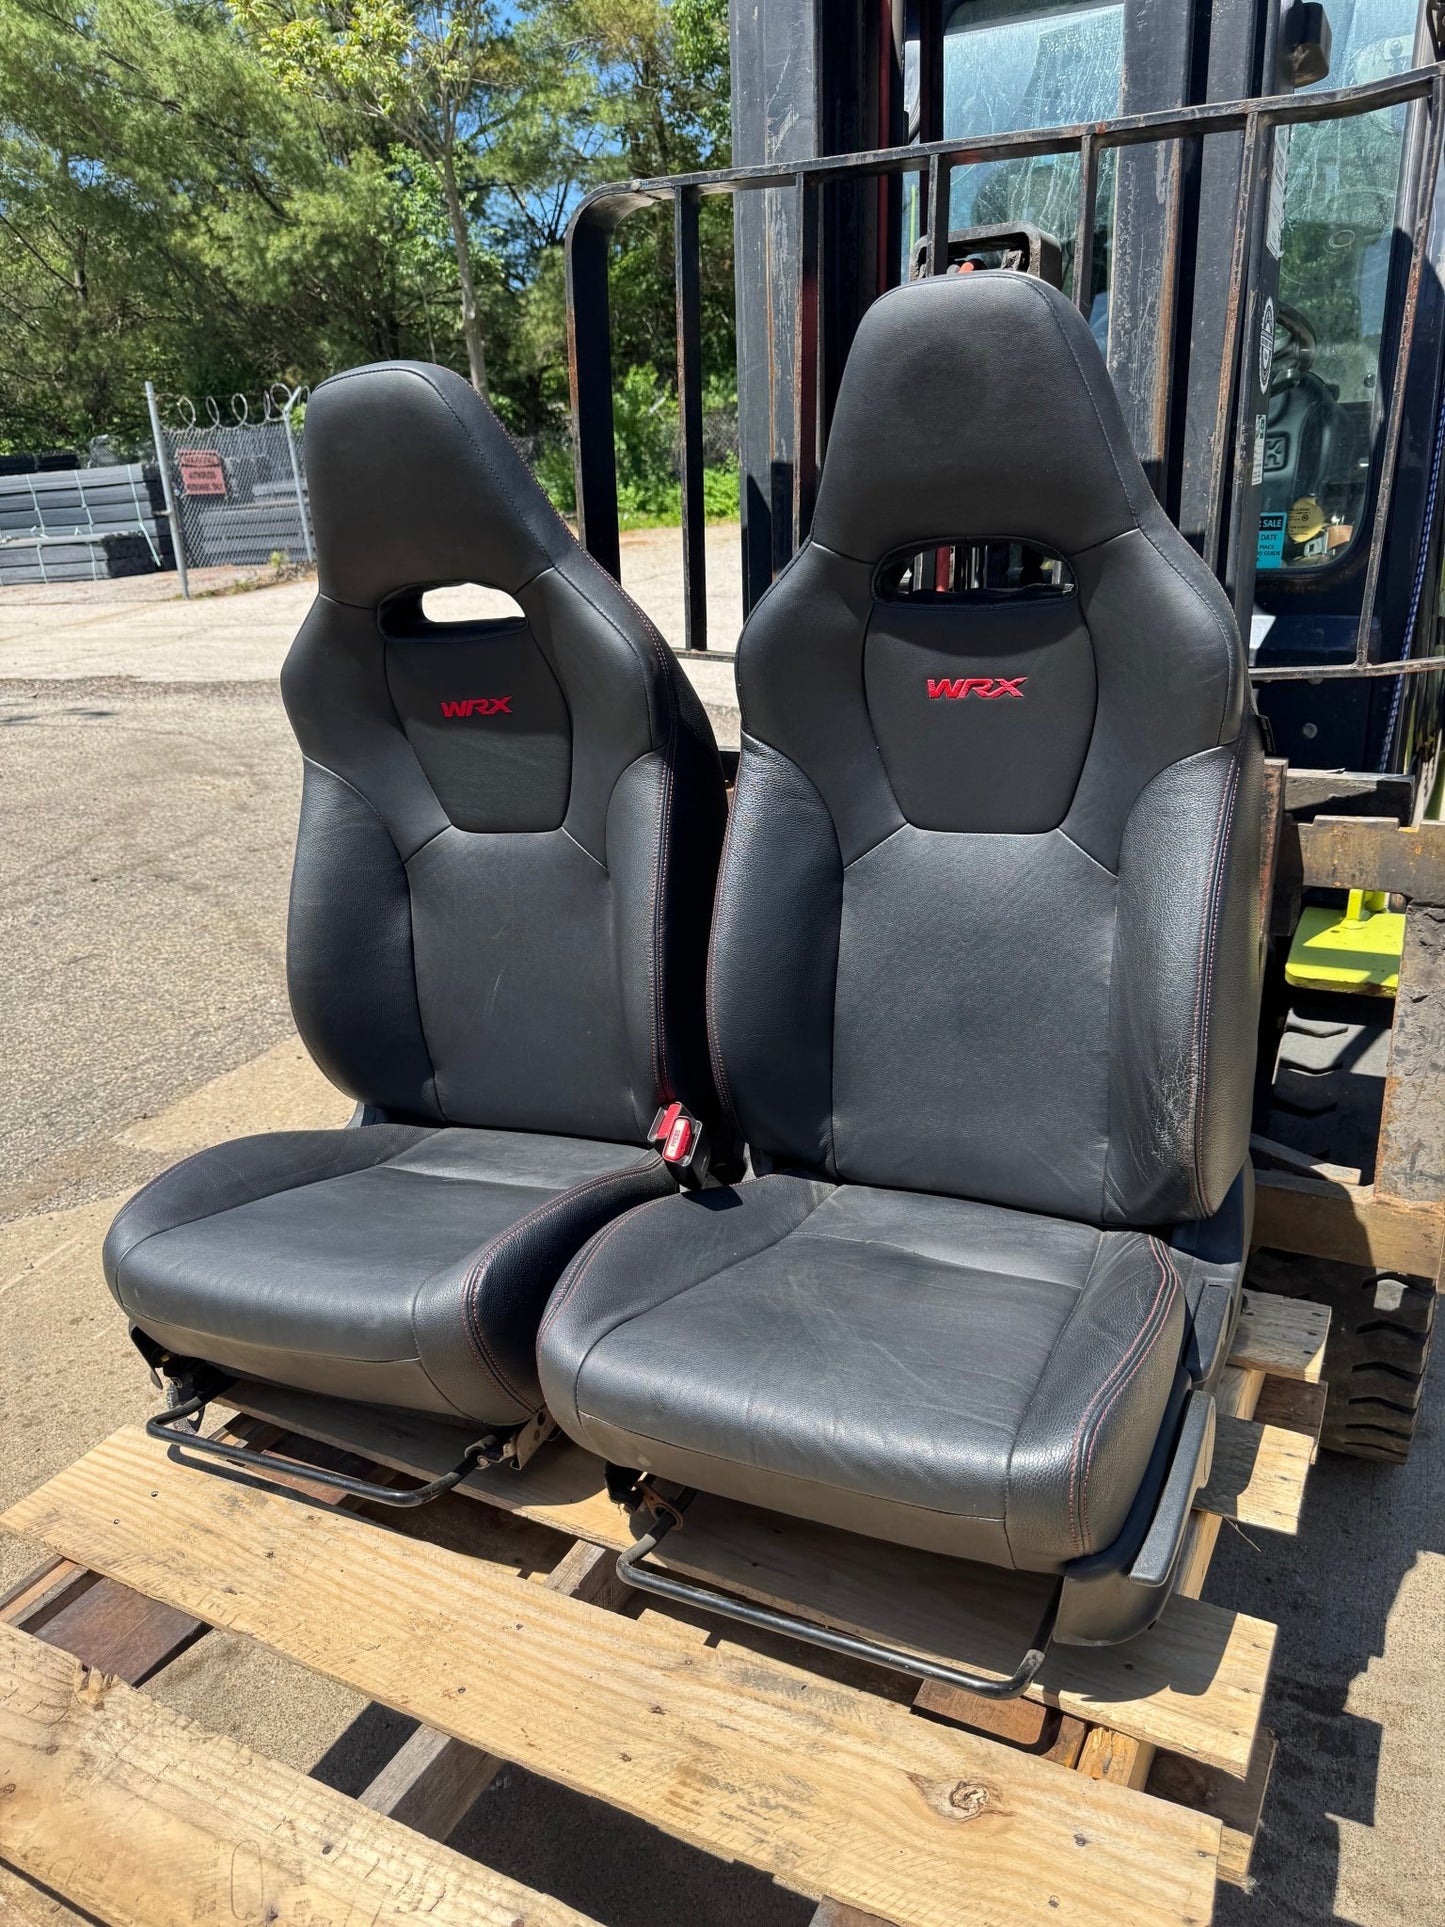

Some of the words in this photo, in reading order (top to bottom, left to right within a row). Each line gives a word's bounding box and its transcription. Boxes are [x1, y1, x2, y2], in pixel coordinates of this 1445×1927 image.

[1262, 519, 1282, 528] SALE
[926, 676, 1028, 699] WRX
[441, 696, 513, 718] WRX
